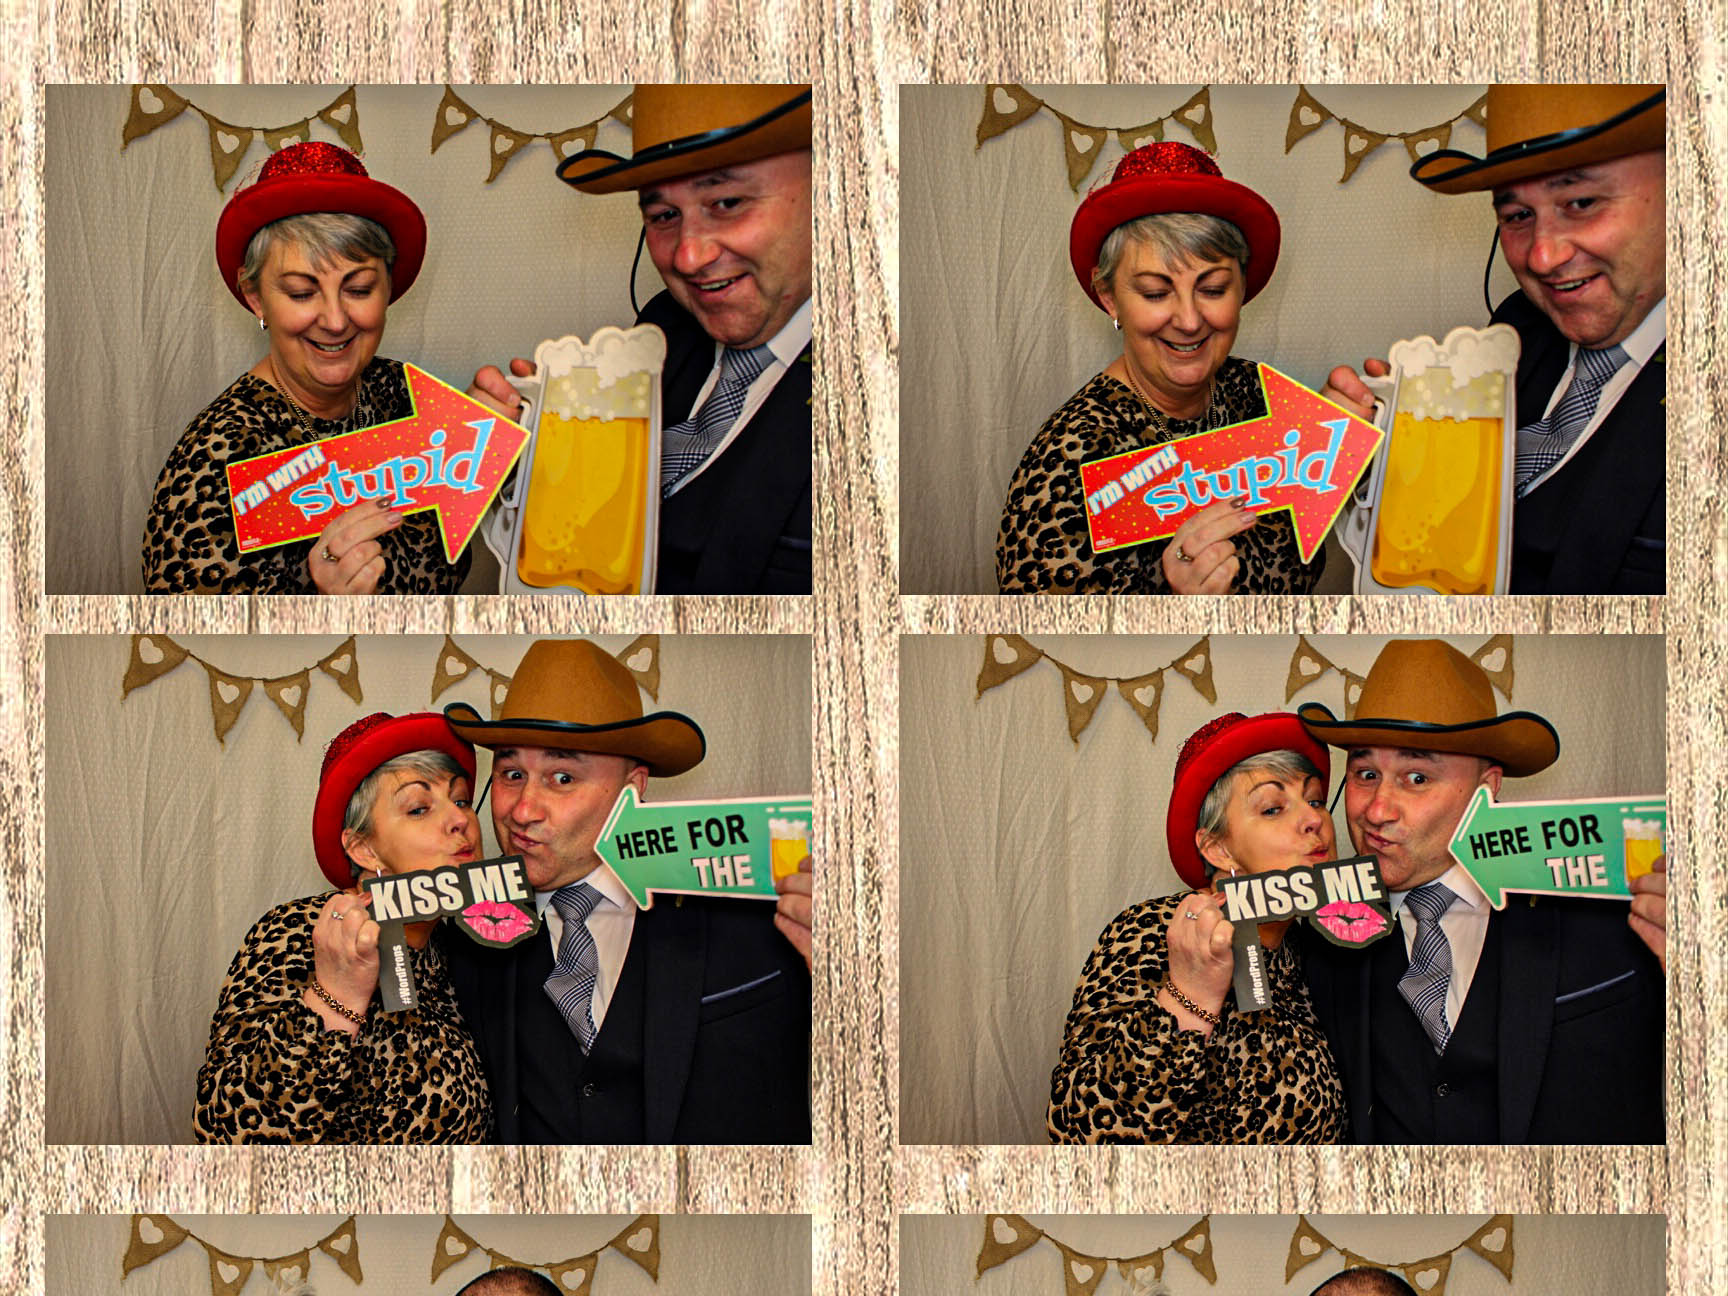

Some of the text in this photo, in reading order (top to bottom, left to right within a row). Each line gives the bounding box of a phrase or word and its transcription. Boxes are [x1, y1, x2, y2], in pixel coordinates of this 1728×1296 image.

[266, 445, 326, 493] WITH
[289, 417, 497, 522] stupid
[1120, 445, 1180, 493] WITH
[1143, 417, 1351, 522] stupid
[615, 814, 749, 860] HERE FOR
[1469, 814, 1603, 860] HERE FOR
[370, 861, 528, 922] KISS ME
[691, 854, 755, 888] THE
[1224, 861, 1382, 922] KISS ME
[1545, 854, 1609, 888] THE
[393, 944, 412, 1005] #WordProps
[1247, 944, 1266, 1005] #WordProps
